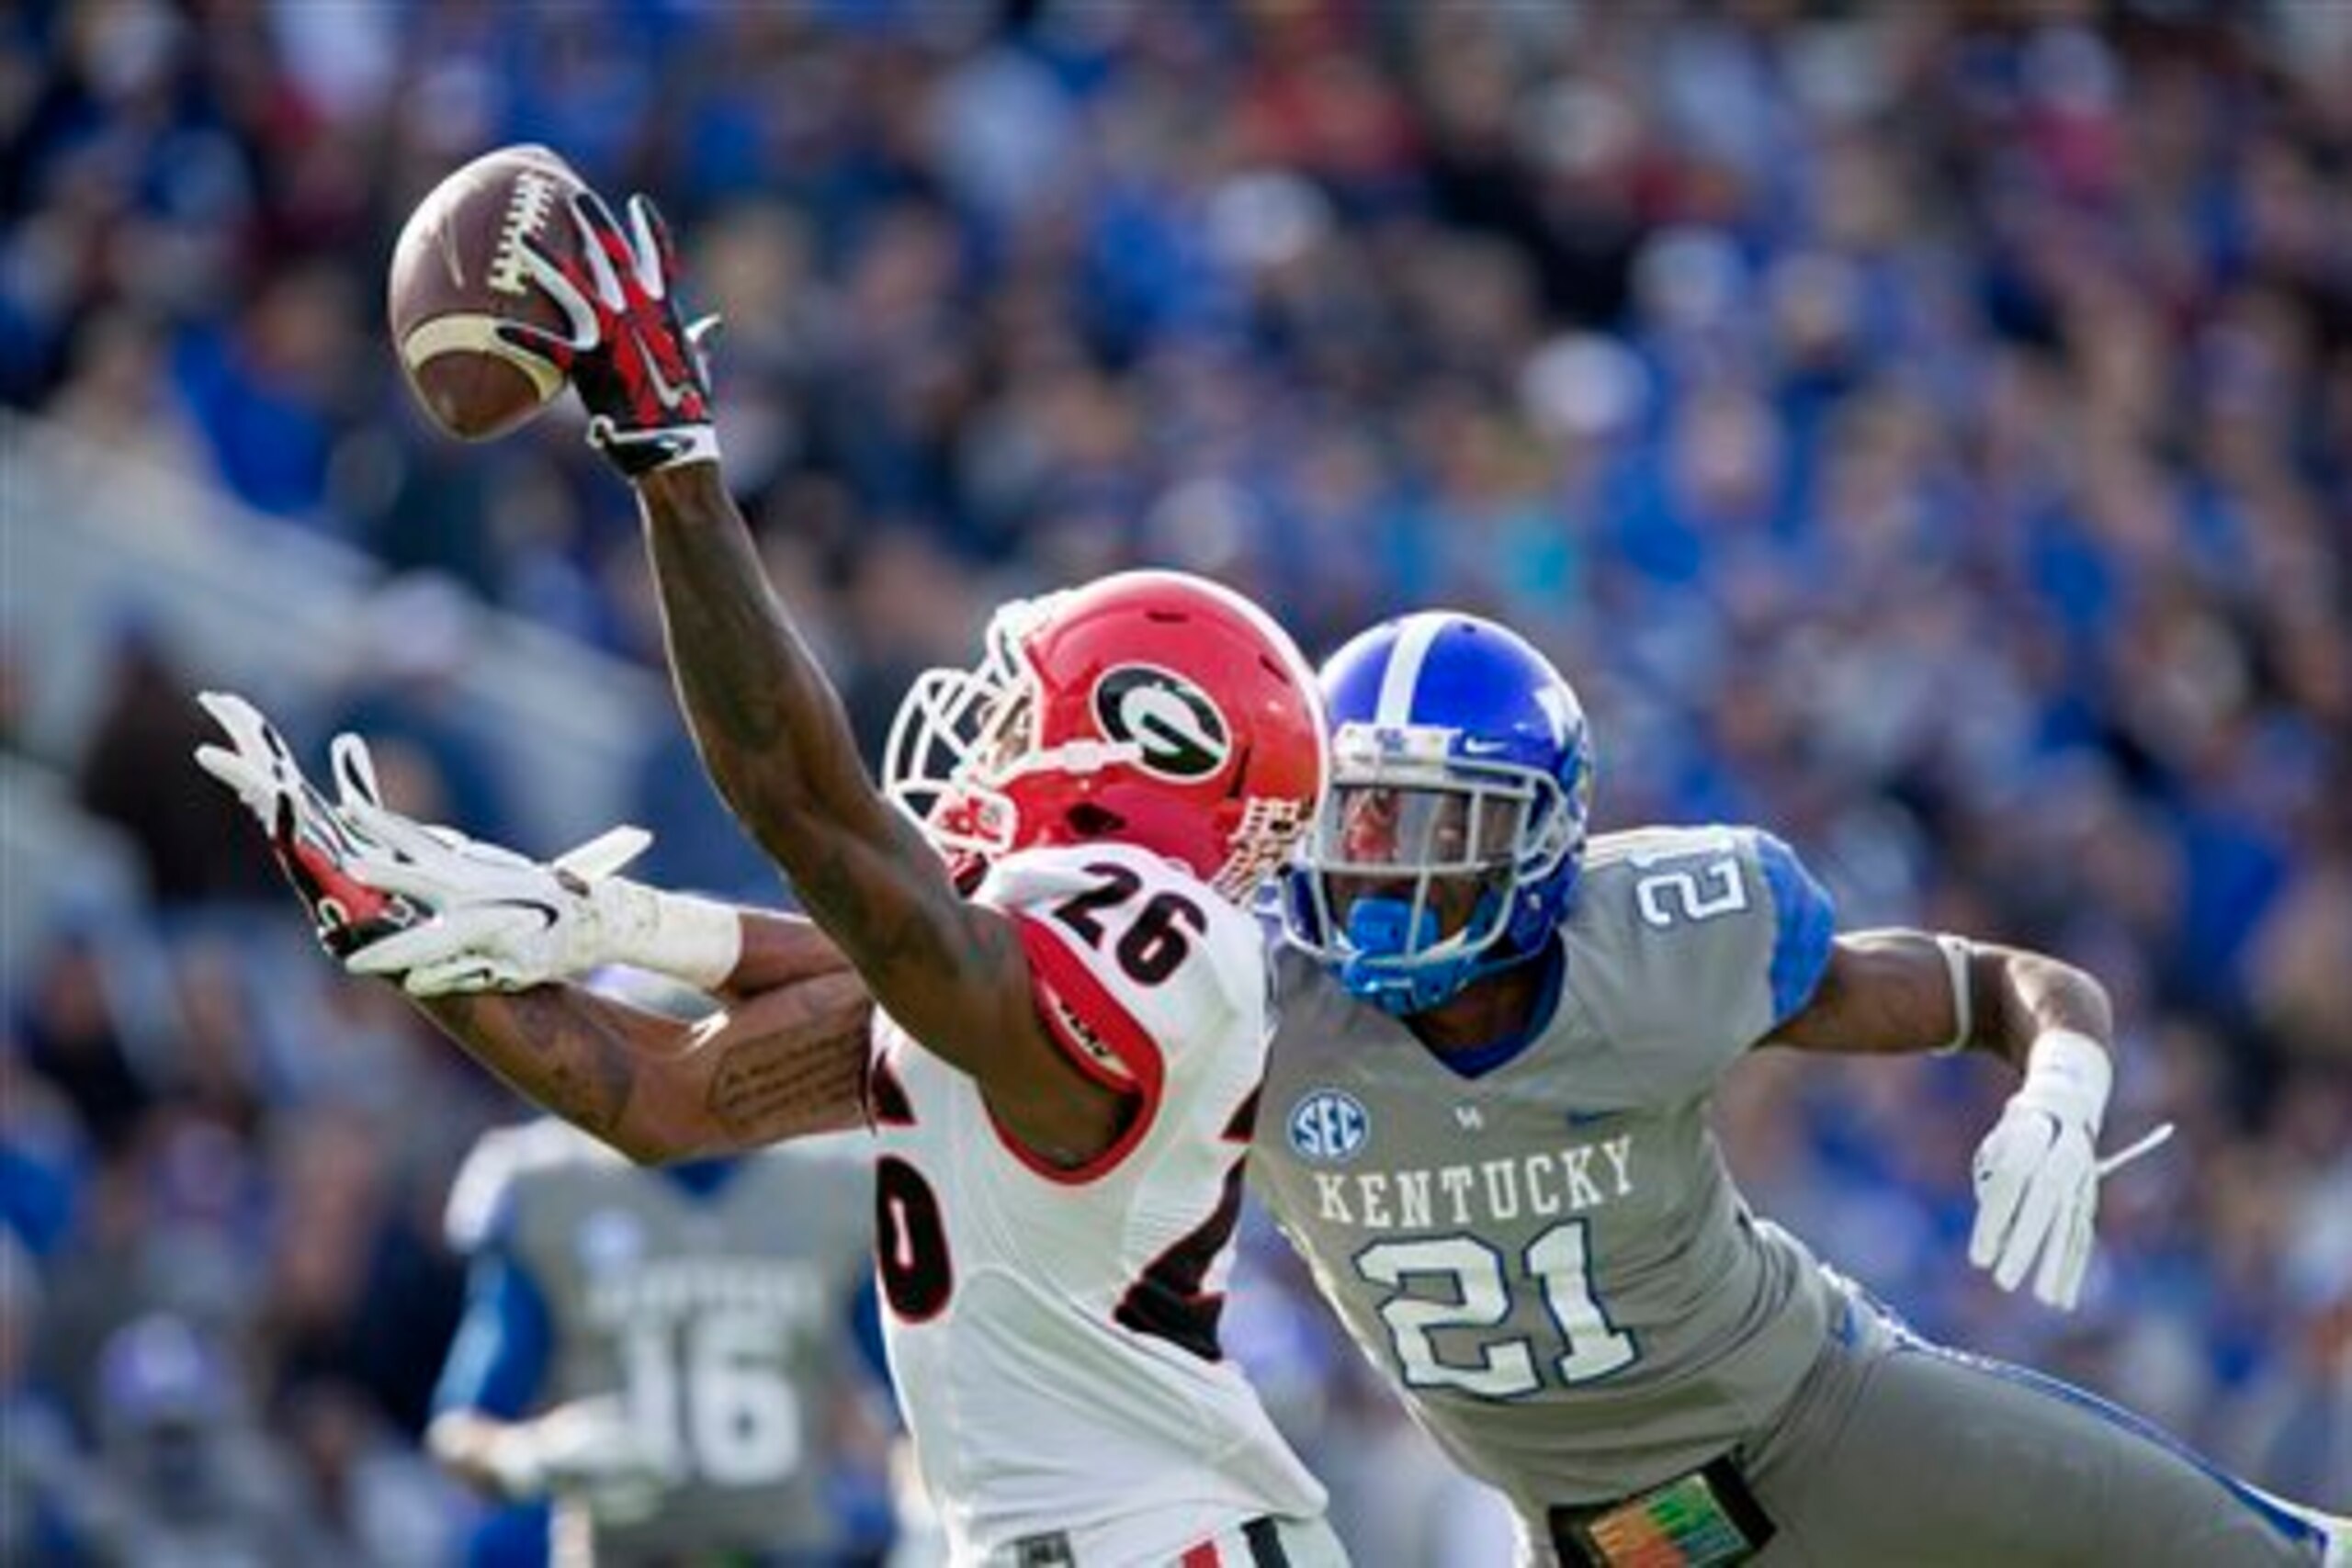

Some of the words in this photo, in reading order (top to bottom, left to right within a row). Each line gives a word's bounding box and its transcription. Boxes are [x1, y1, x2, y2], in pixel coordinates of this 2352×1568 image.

[1098, 669, 1229, 781] G
[1054, 862, 1206, 985] 26
[1293, 1095, 1366, 1156] SEC
[1314, 1135, 1634, 1228] KENTUCKY
[1354, 1219, 1640, 1399] 21
[623, 1297, 801, 1487] 16
